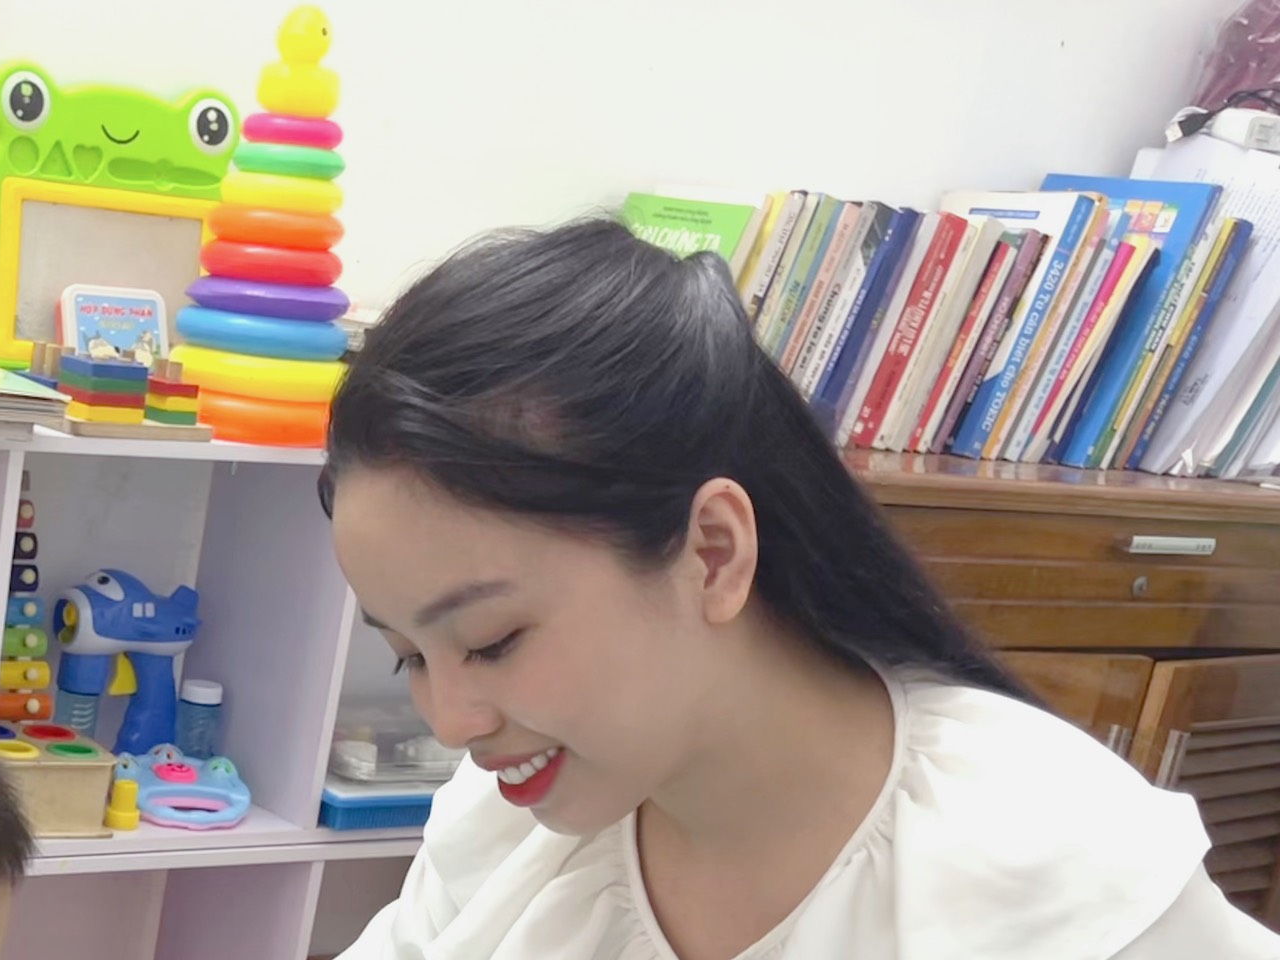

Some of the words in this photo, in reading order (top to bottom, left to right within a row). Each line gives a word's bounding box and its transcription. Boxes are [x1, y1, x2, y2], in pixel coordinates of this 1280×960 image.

[1044, 260, 1065, 291] 3420
[1001, 364, 1015, 388] cho
[982, 390, 1004, 430] TOEIC
